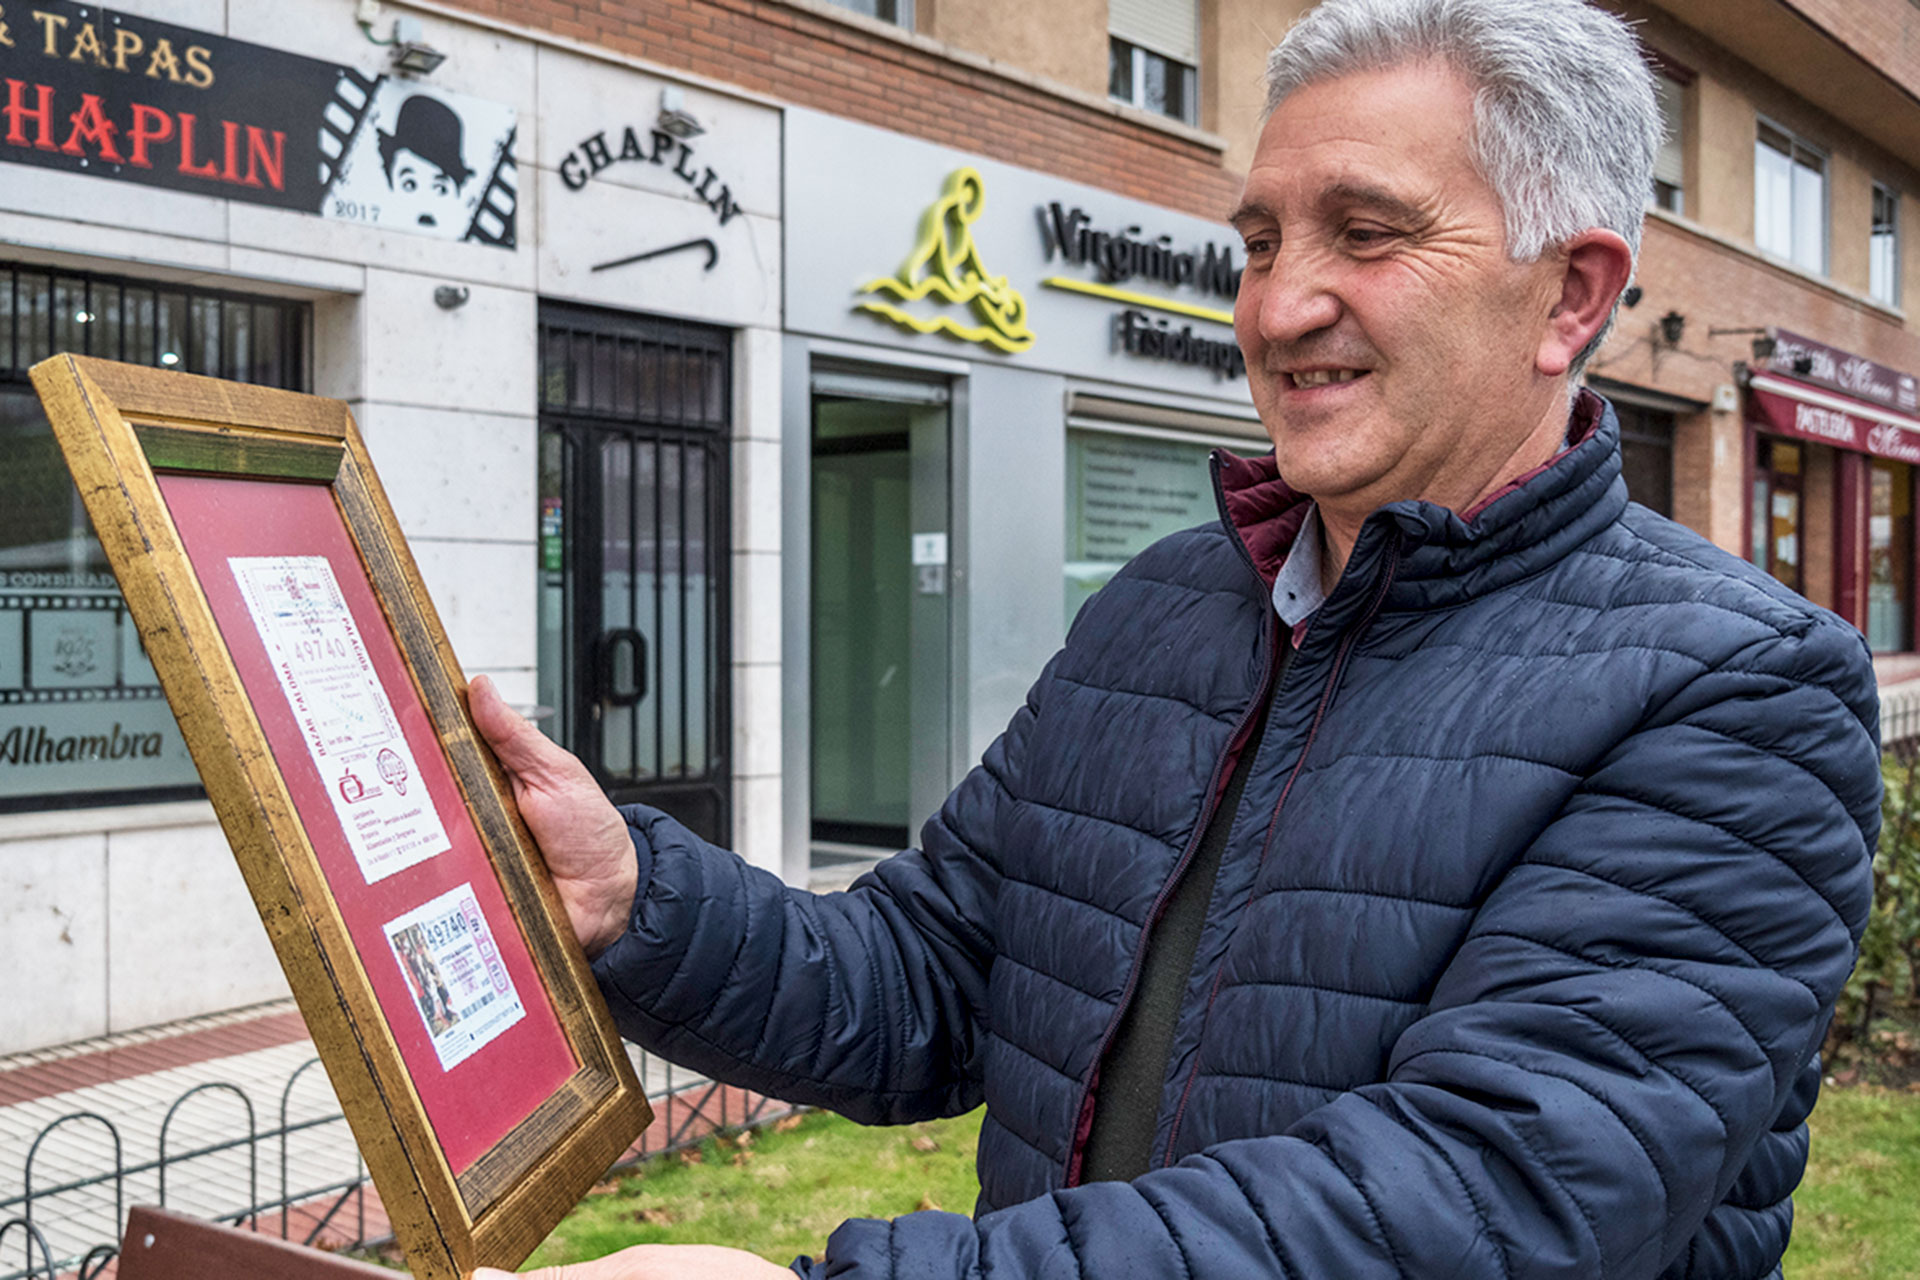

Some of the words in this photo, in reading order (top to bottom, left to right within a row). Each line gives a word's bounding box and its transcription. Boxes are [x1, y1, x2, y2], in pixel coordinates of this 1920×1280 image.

[32, 10, 215, 89] TAPAS
[559, 125, 744, 227] CHAPLIN
[335, 199, 380, 222] 2017
[1035, 202, 1197, 286] Virginia
[1110, 309, 1248, 383] Fisioterap
[294, 637, 347, 663] 49740
[0, 722, 163, 767] Alhambra
[426, 911, 468, 945] 49740
